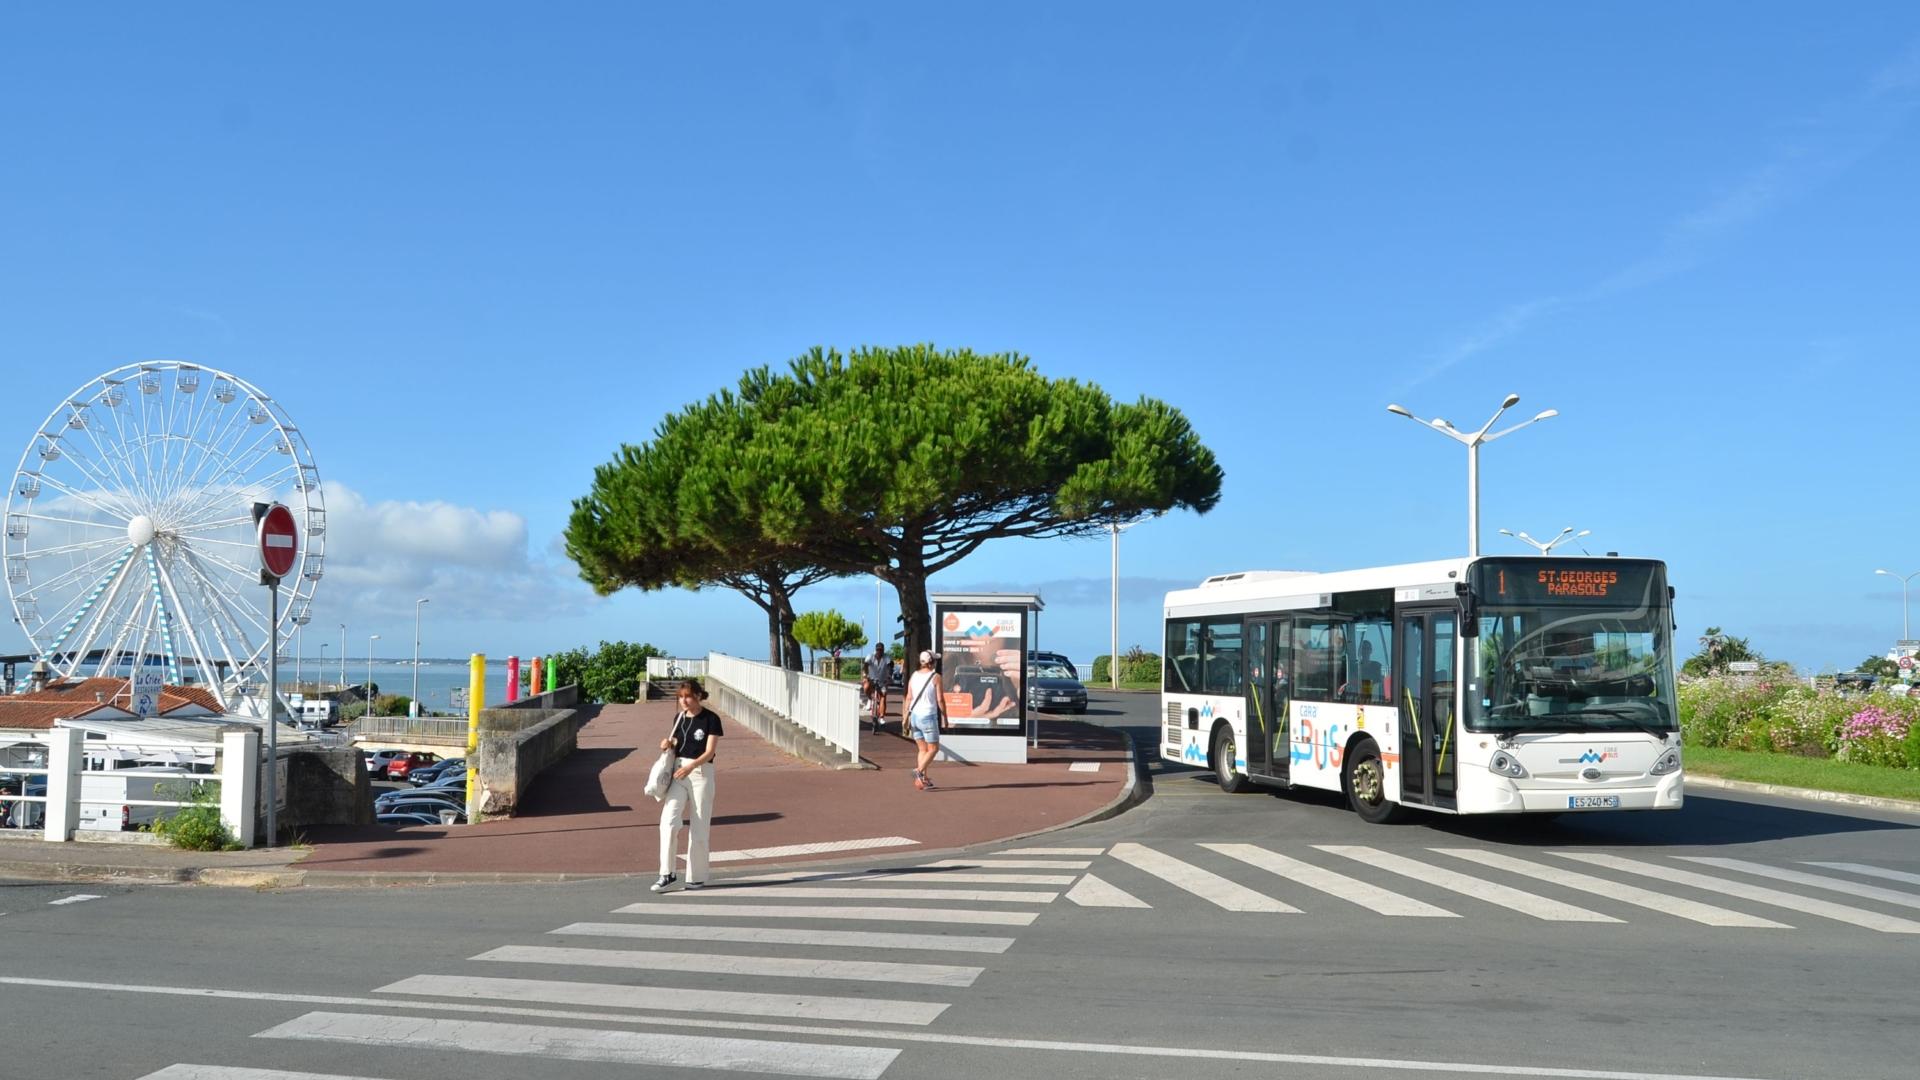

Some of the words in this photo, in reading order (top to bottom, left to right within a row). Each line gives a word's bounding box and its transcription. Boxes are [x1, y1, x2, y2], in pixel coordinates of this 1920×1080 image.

[1498, 570, 1505, 595] 1
[1538, 570, 1617, 583] ST.GEORGES
[1547, 583, 1607, 595] PARASOLS
[1293, 719, 1344, 770] BUS
